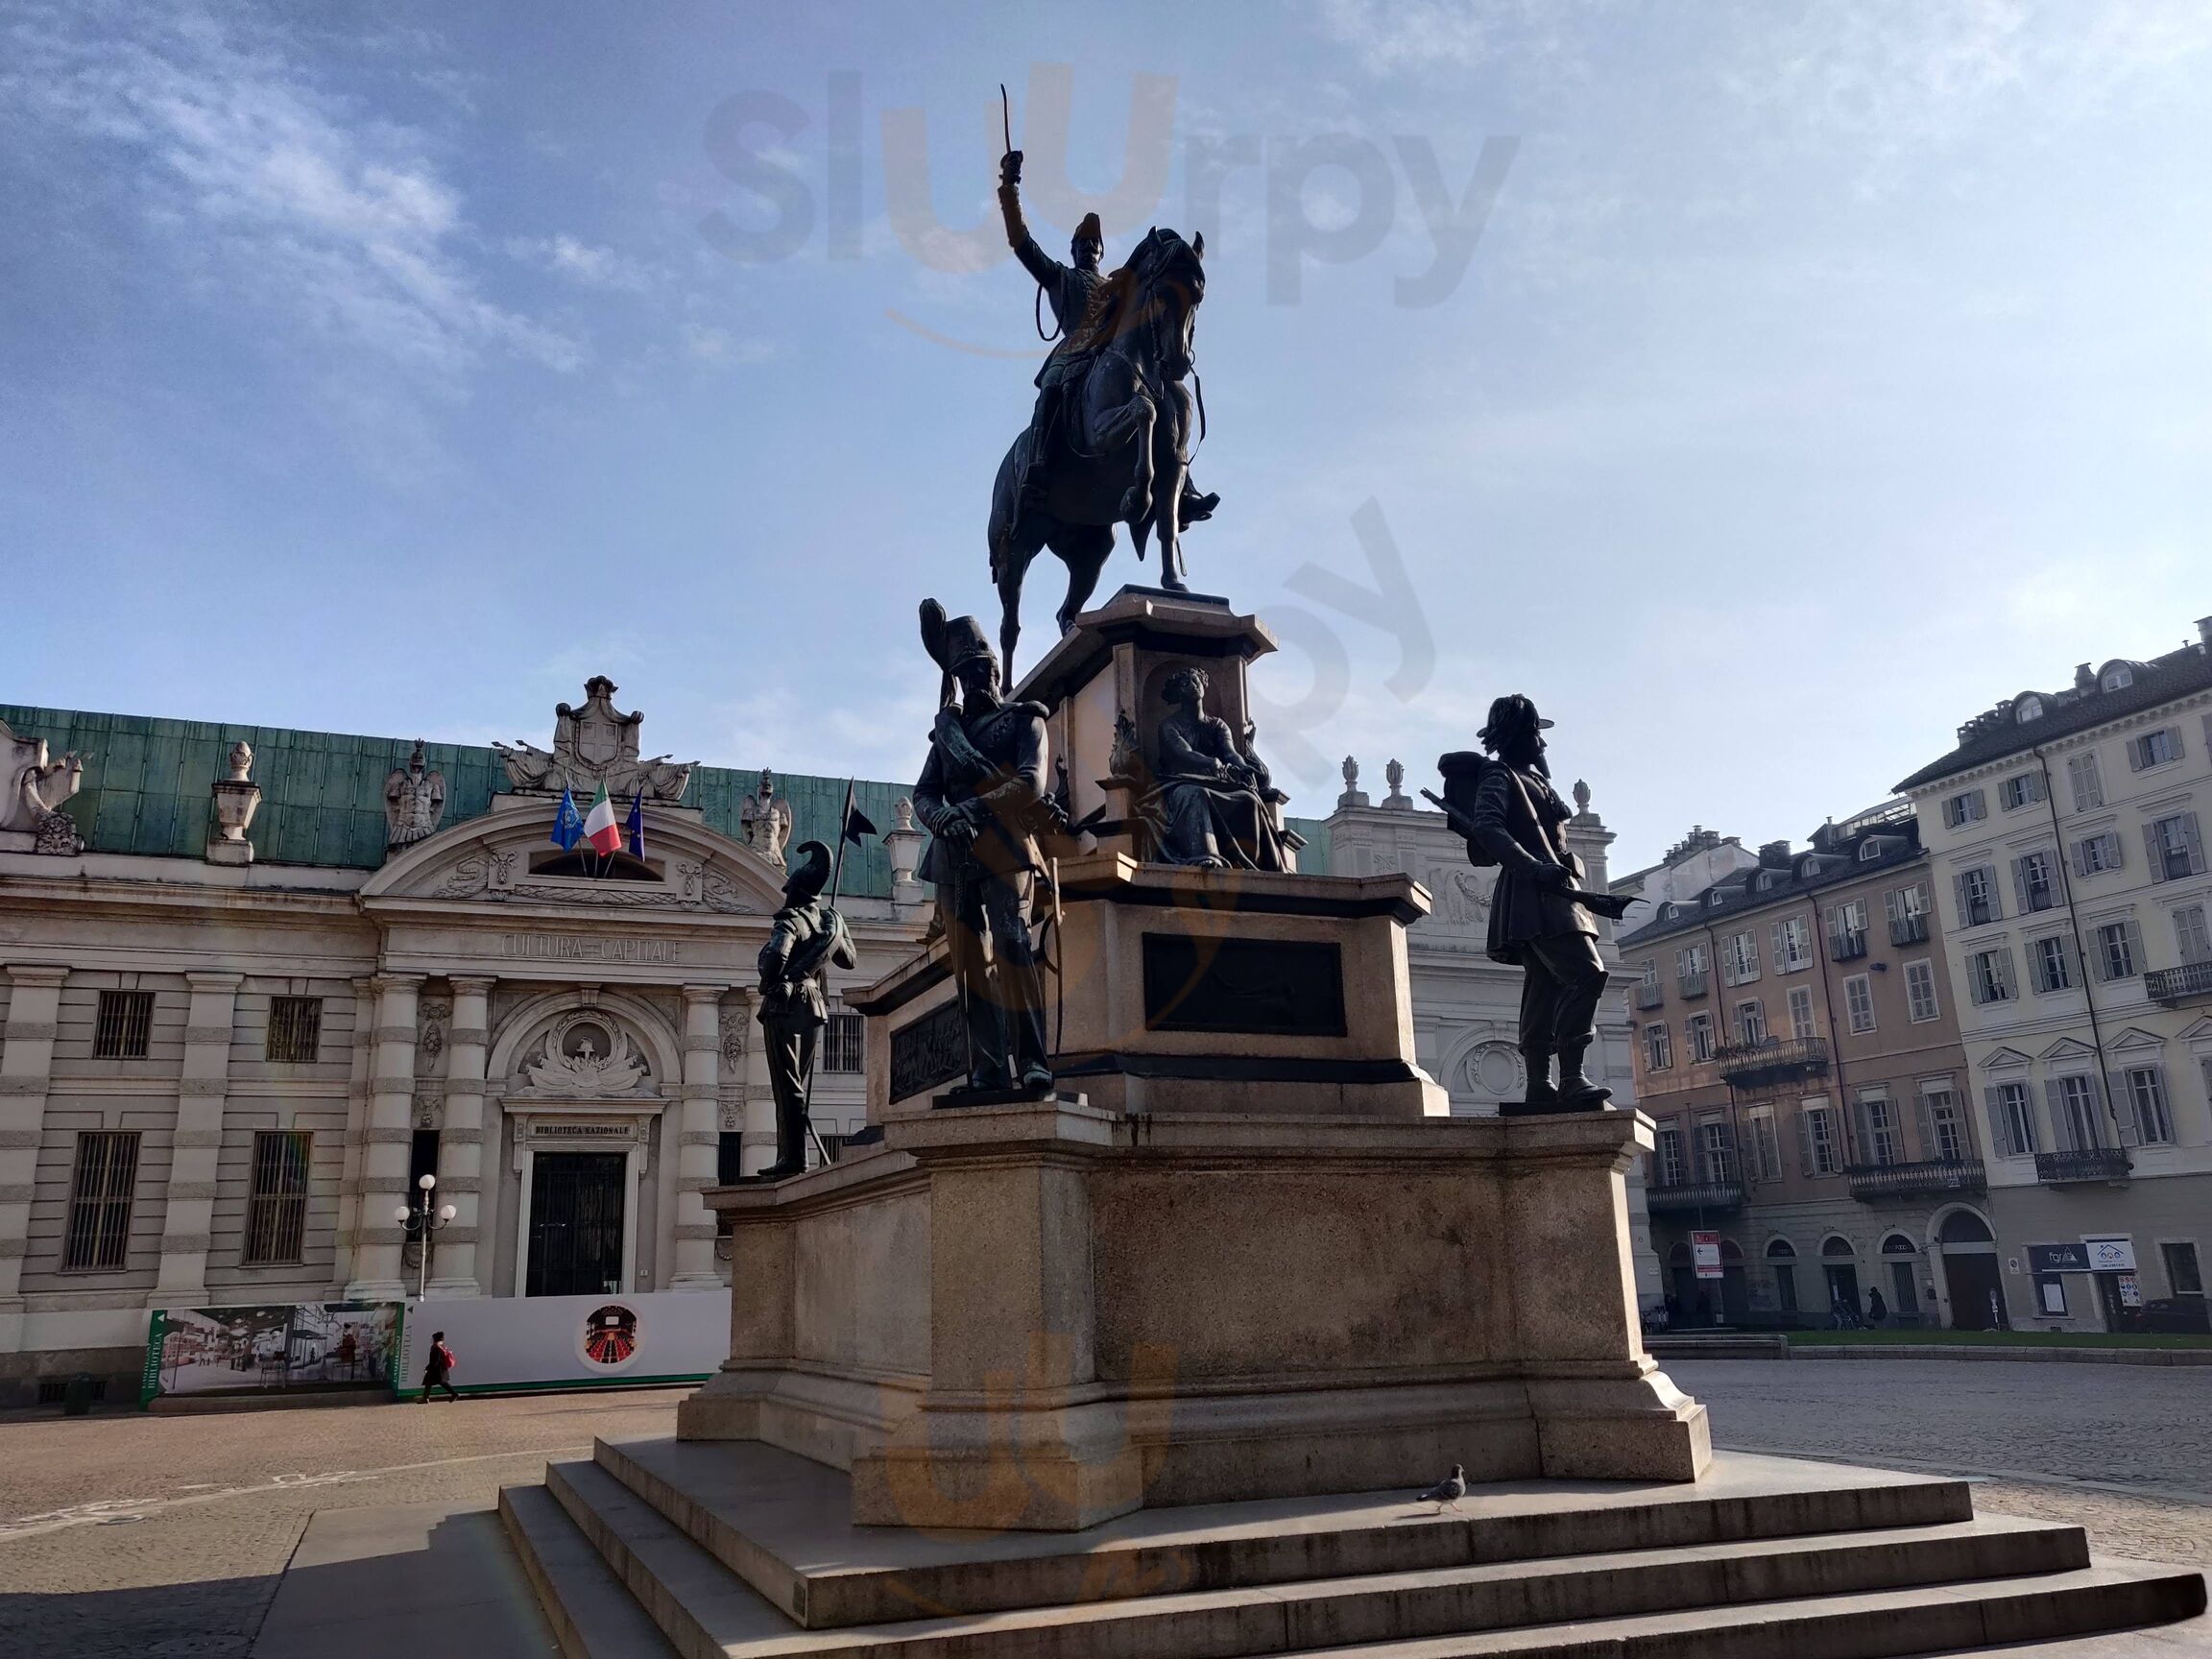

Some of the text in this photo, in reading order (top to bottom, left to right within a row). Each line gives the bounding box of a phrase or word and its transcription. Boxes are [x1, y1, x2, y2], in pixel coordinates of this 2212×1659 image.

[501, 933, 583, 958] CULTURA
[601, 939, 680, 961] CAPITALE
[148, 1333, 162, 1388] BIBLIOTECA
